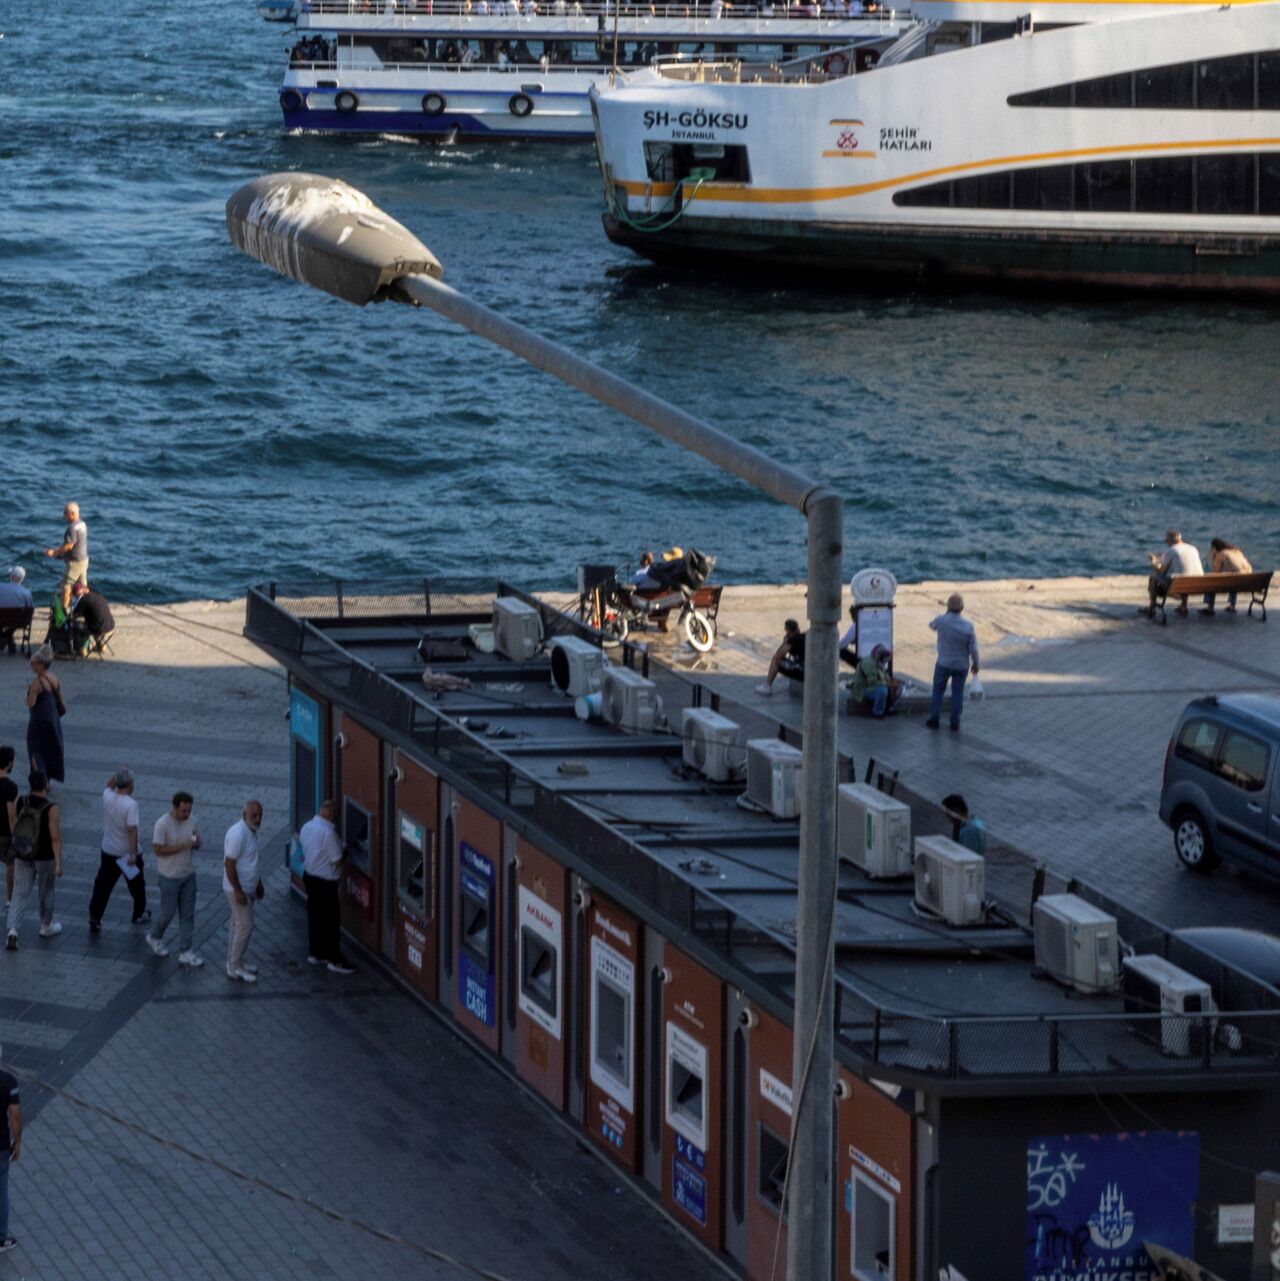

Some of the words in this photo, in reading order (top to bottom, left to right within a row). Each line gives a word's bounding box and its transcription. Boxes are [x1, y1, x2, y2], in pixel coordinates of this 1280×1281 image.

[643, 108, 749, 130] ŞH-GÖKSU
[671, 129, 716, 141] İSTANBUL
[880, 125, 918, 140] ŞEHİR
[880, 139, 932, 152] HATLARI
